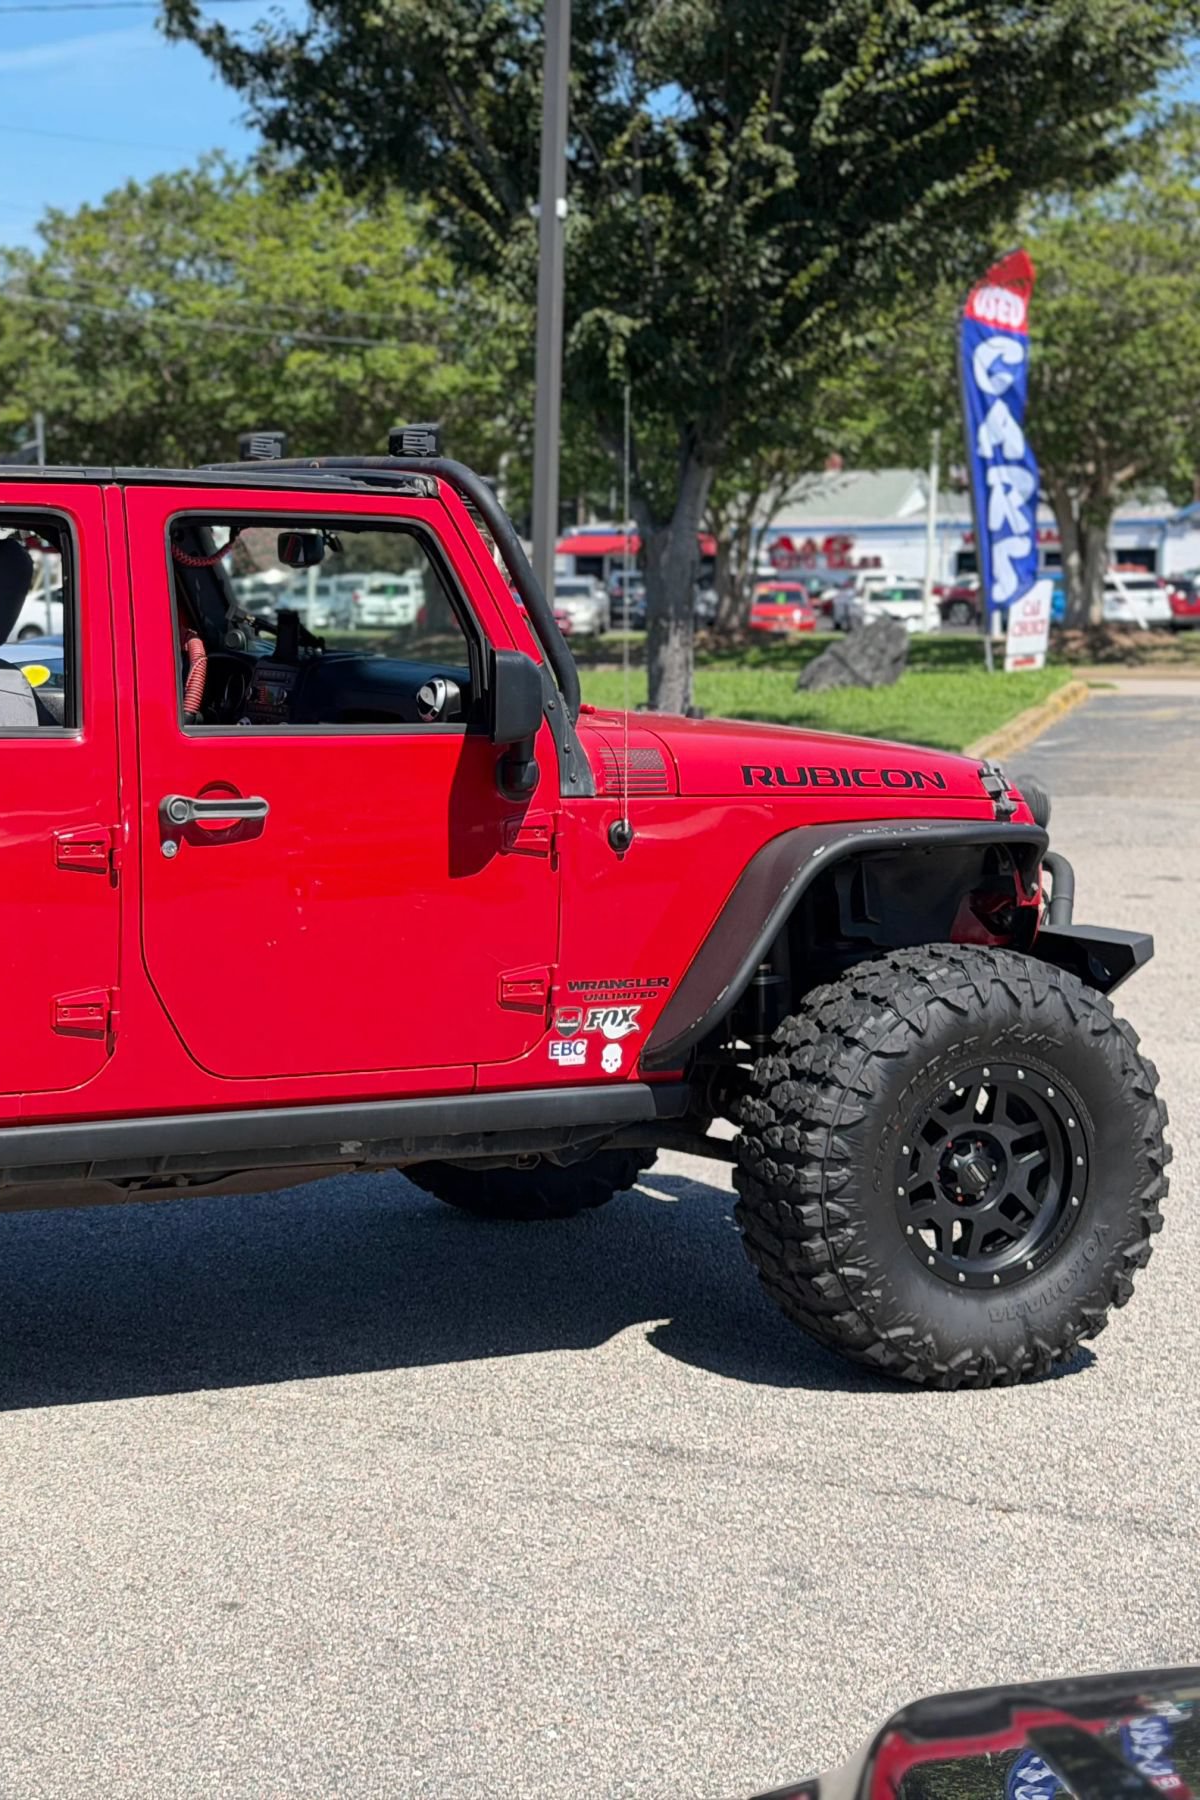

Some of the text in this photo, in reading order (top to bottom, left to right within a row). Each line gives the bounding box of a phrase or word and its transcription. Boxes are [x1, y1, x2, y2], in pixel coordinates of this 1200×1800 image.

[973, 286, 1025, 329] USED
[972, 335, 1035, 604] CARS
[741, 765, 947, 791] RUBICON
[567, 976, 671, 992] WRANGLER
[583, 991, 658, 1002] UNLIMITED
[585, 1008, 639, 1029] FOX
[550, 1040, 586, 1057] EBC
